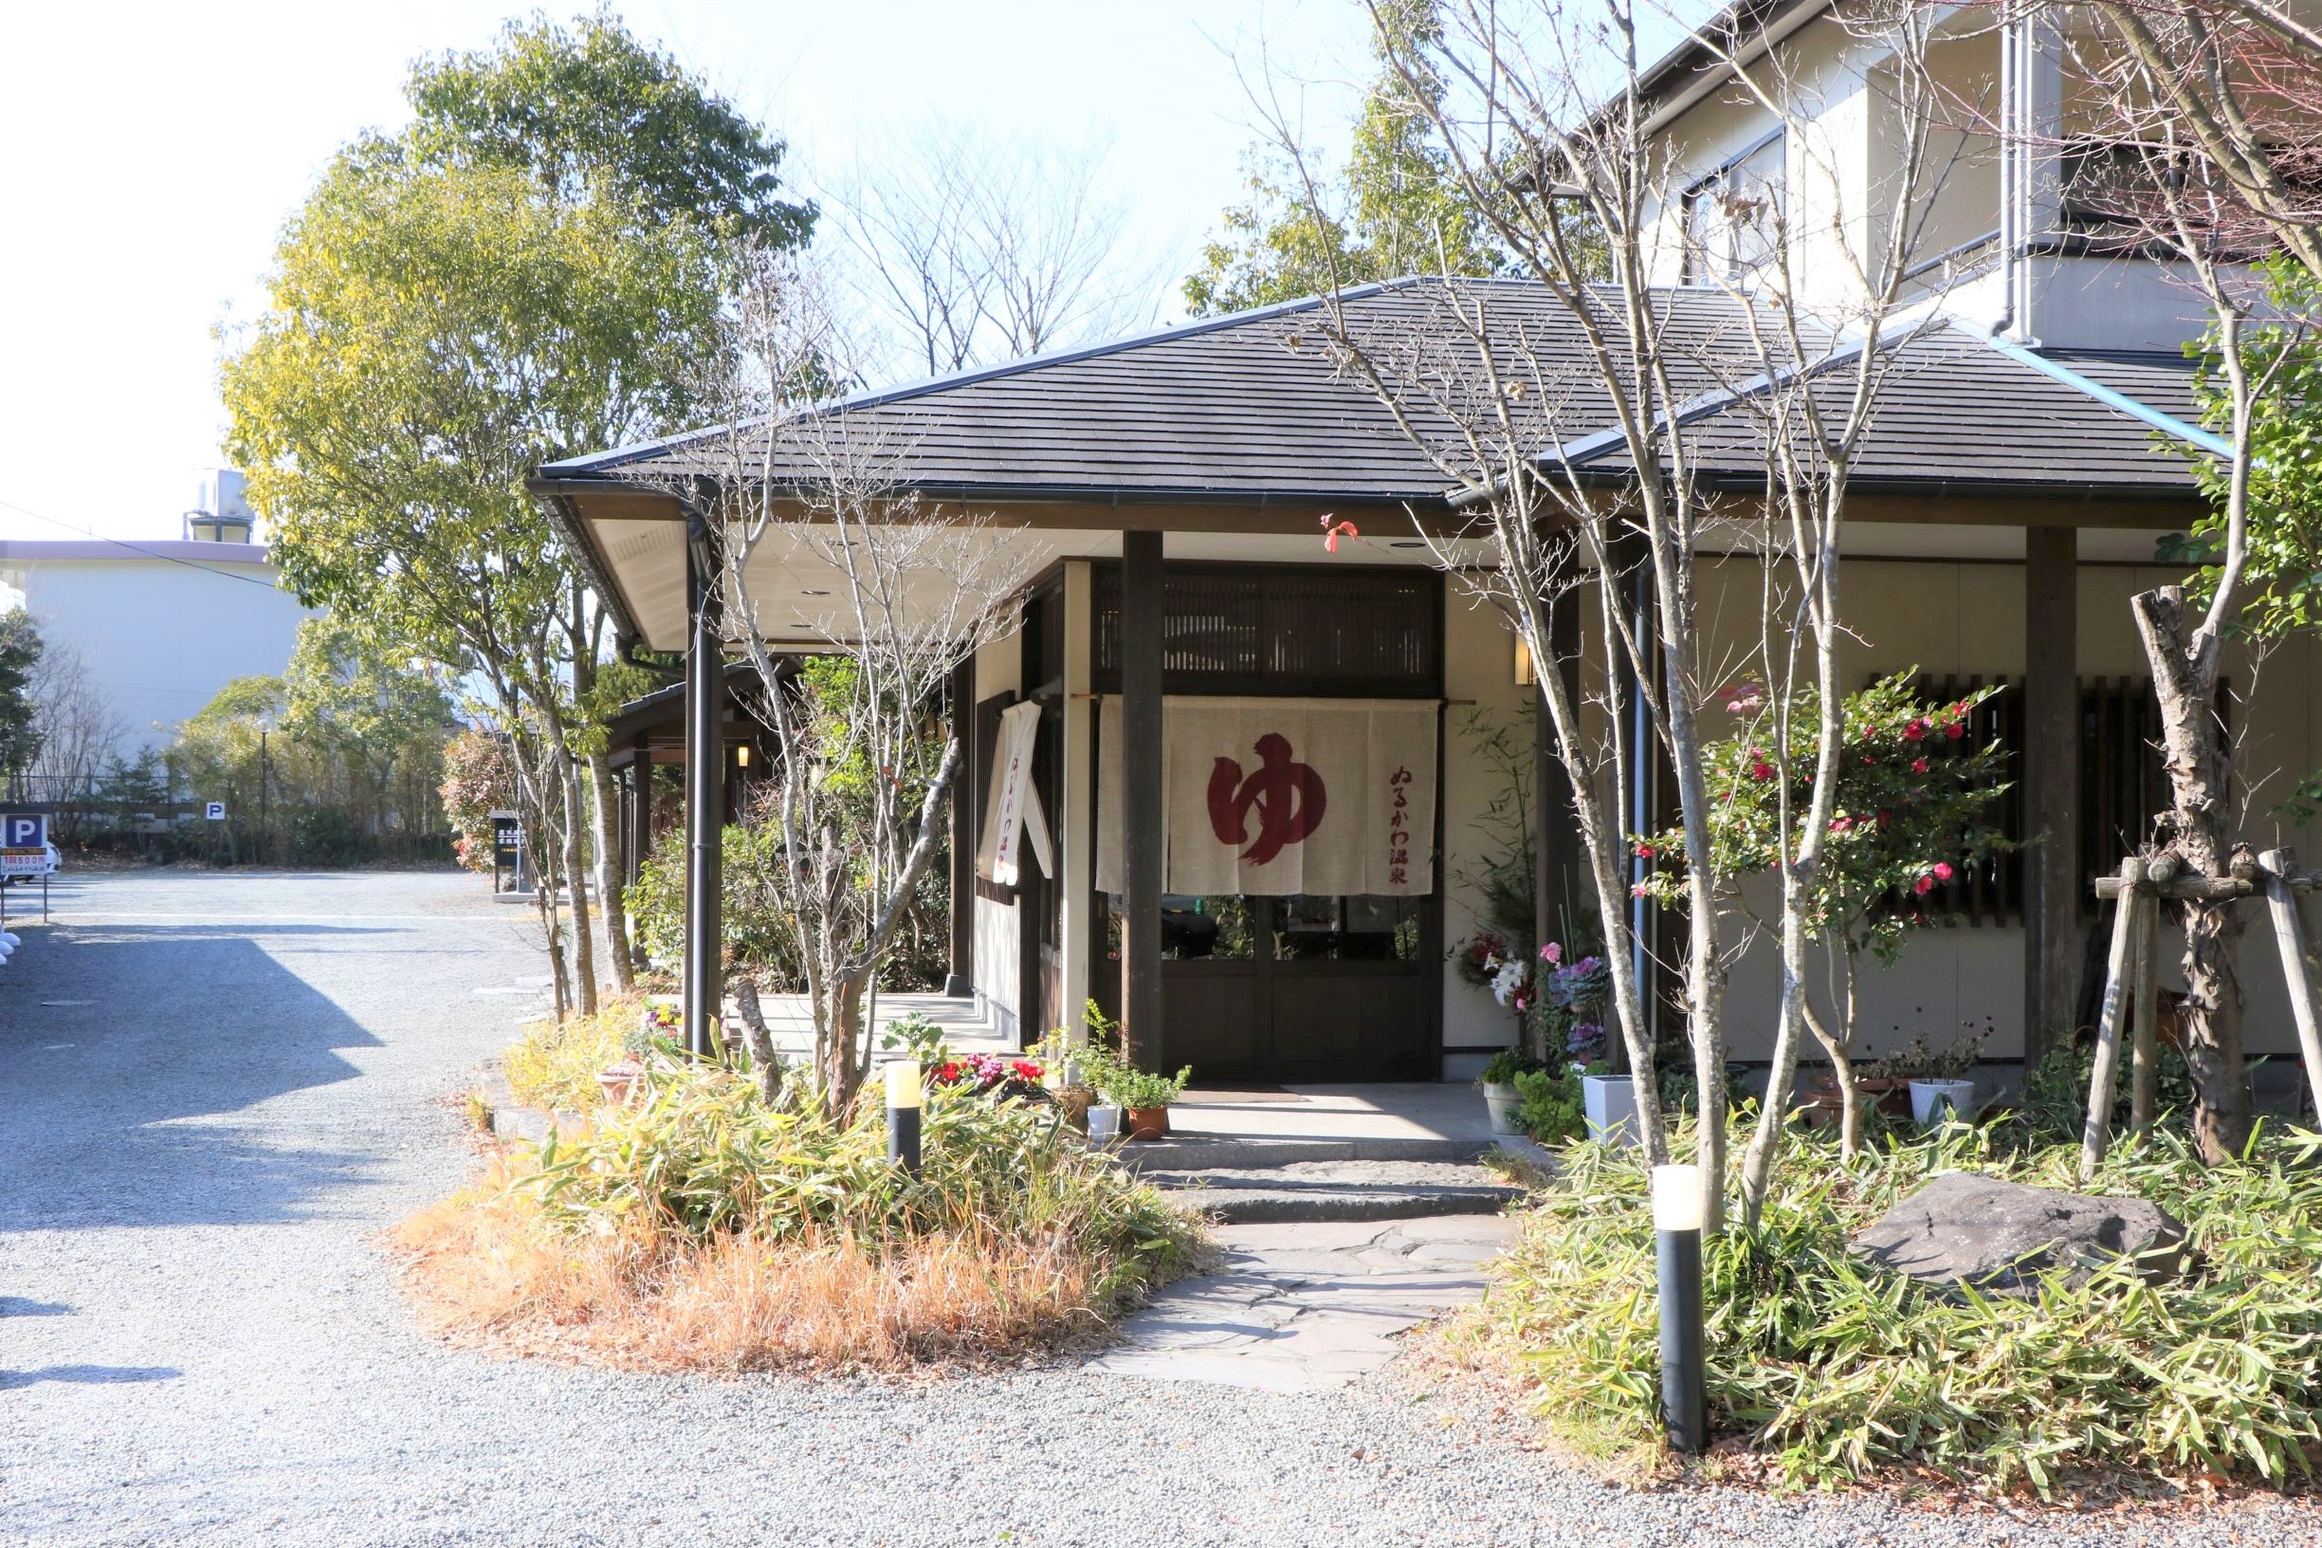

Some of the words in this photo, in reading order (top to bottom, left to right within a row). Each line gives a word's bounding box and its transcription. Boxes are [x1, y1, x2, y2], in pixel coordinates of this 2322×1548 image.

[15, 819, 36, 843] P
[209, 804, 222, 817] P
[1207, 732, 1327, 866] ゆ
[1388, 765, 1413, 884] ぬるかわ温泉
